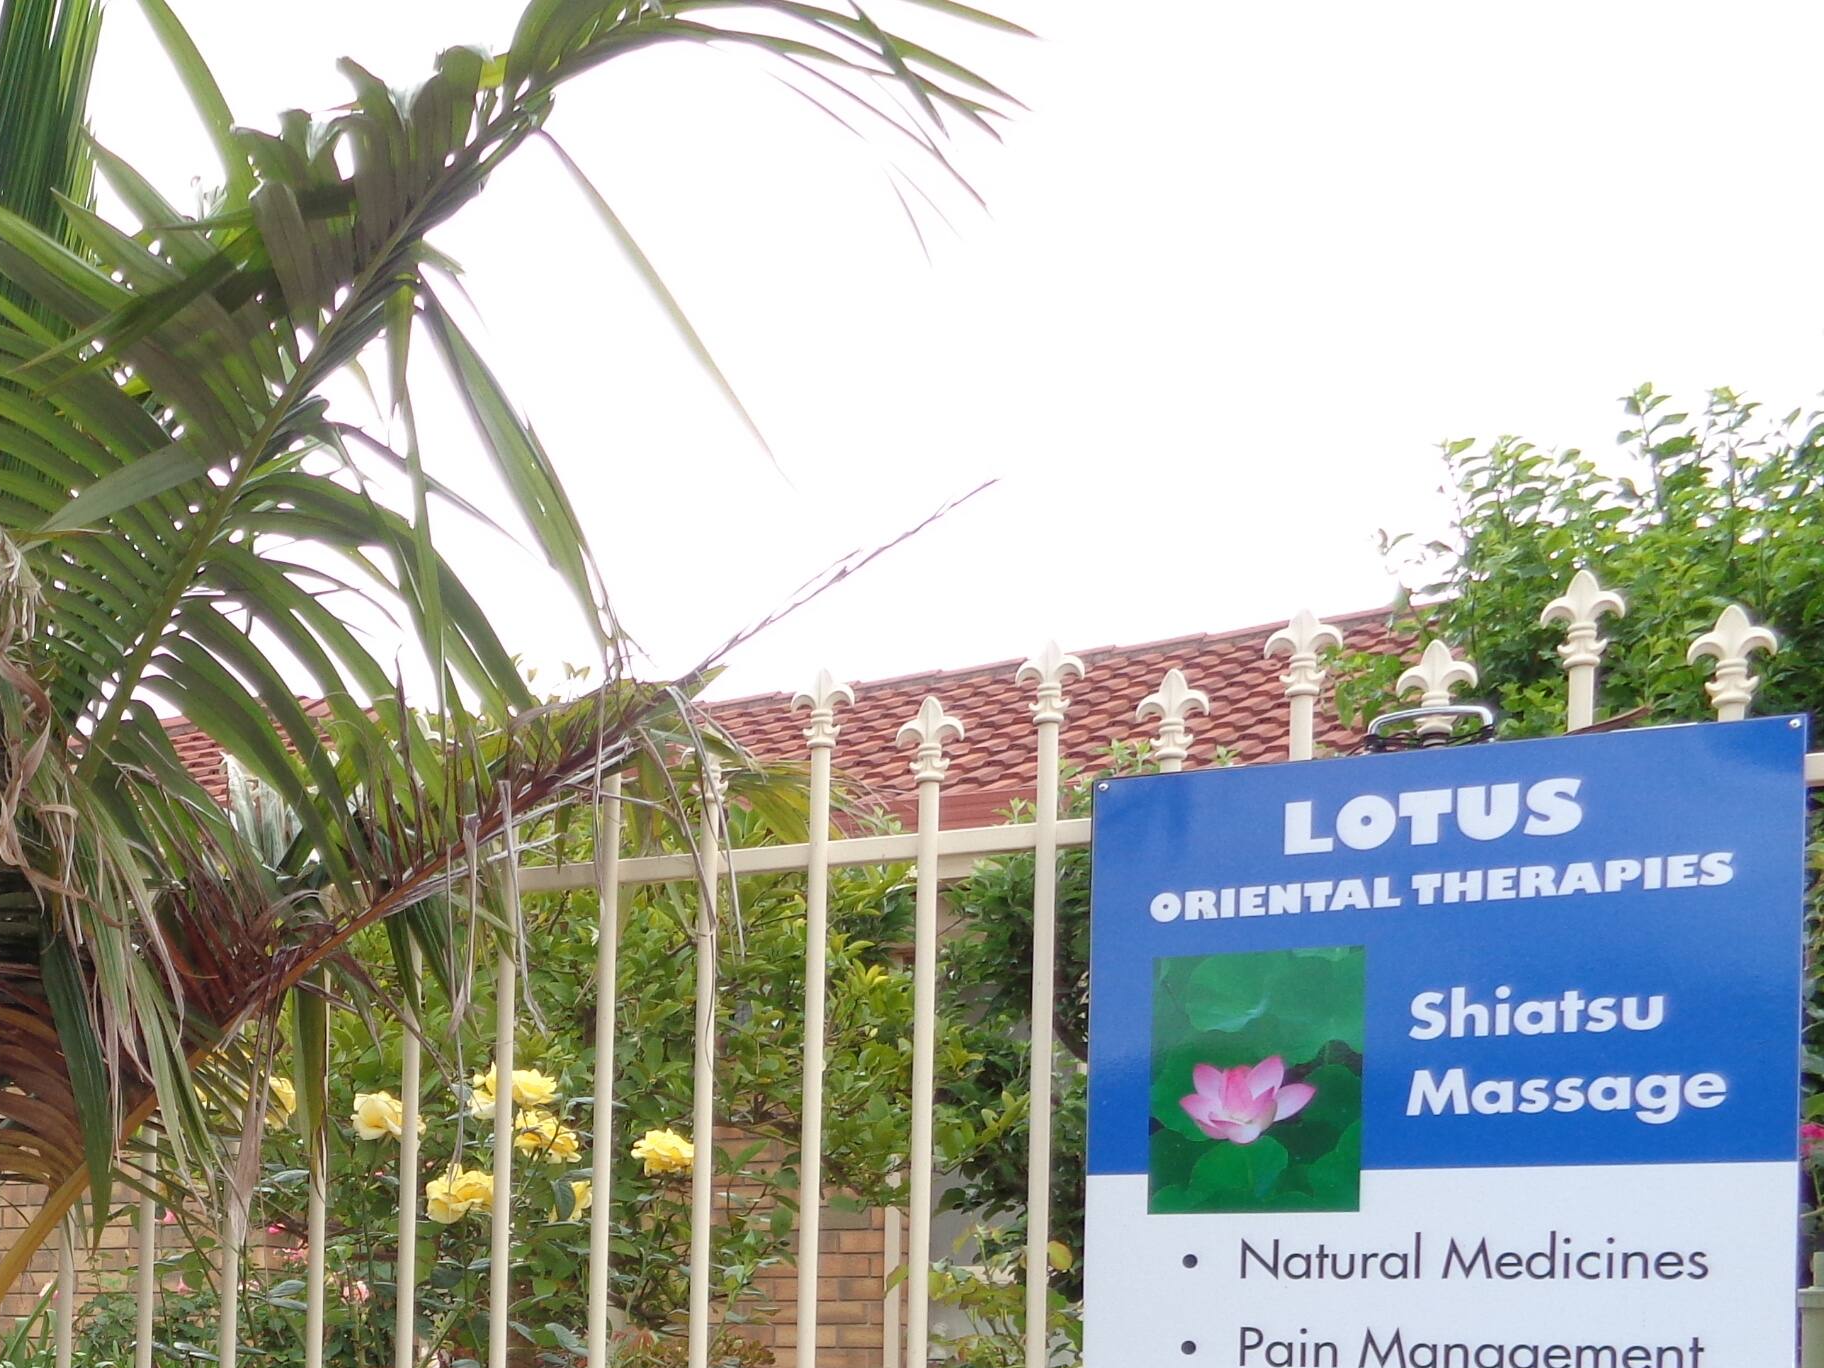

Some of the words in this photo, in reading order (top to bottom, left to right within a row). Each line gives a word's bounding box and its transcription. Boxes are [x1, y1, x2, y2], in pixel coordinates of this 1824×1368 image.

[1283, 776, 1584, 856] LOTUS
[1149, 876, 1401, 923] ORIENTAL
[1411, 851, 1735, 905] THERAPIES
[1408, 985, 1665, 1040] Shiatsu
[1406, 1068, 1727, 1125] Massage
[1240, 1231, 1422, 1280] Natural
[1441, 1230, 1710, 1280] Medicines
[1239, 1326, 1338, 1368] Pain
